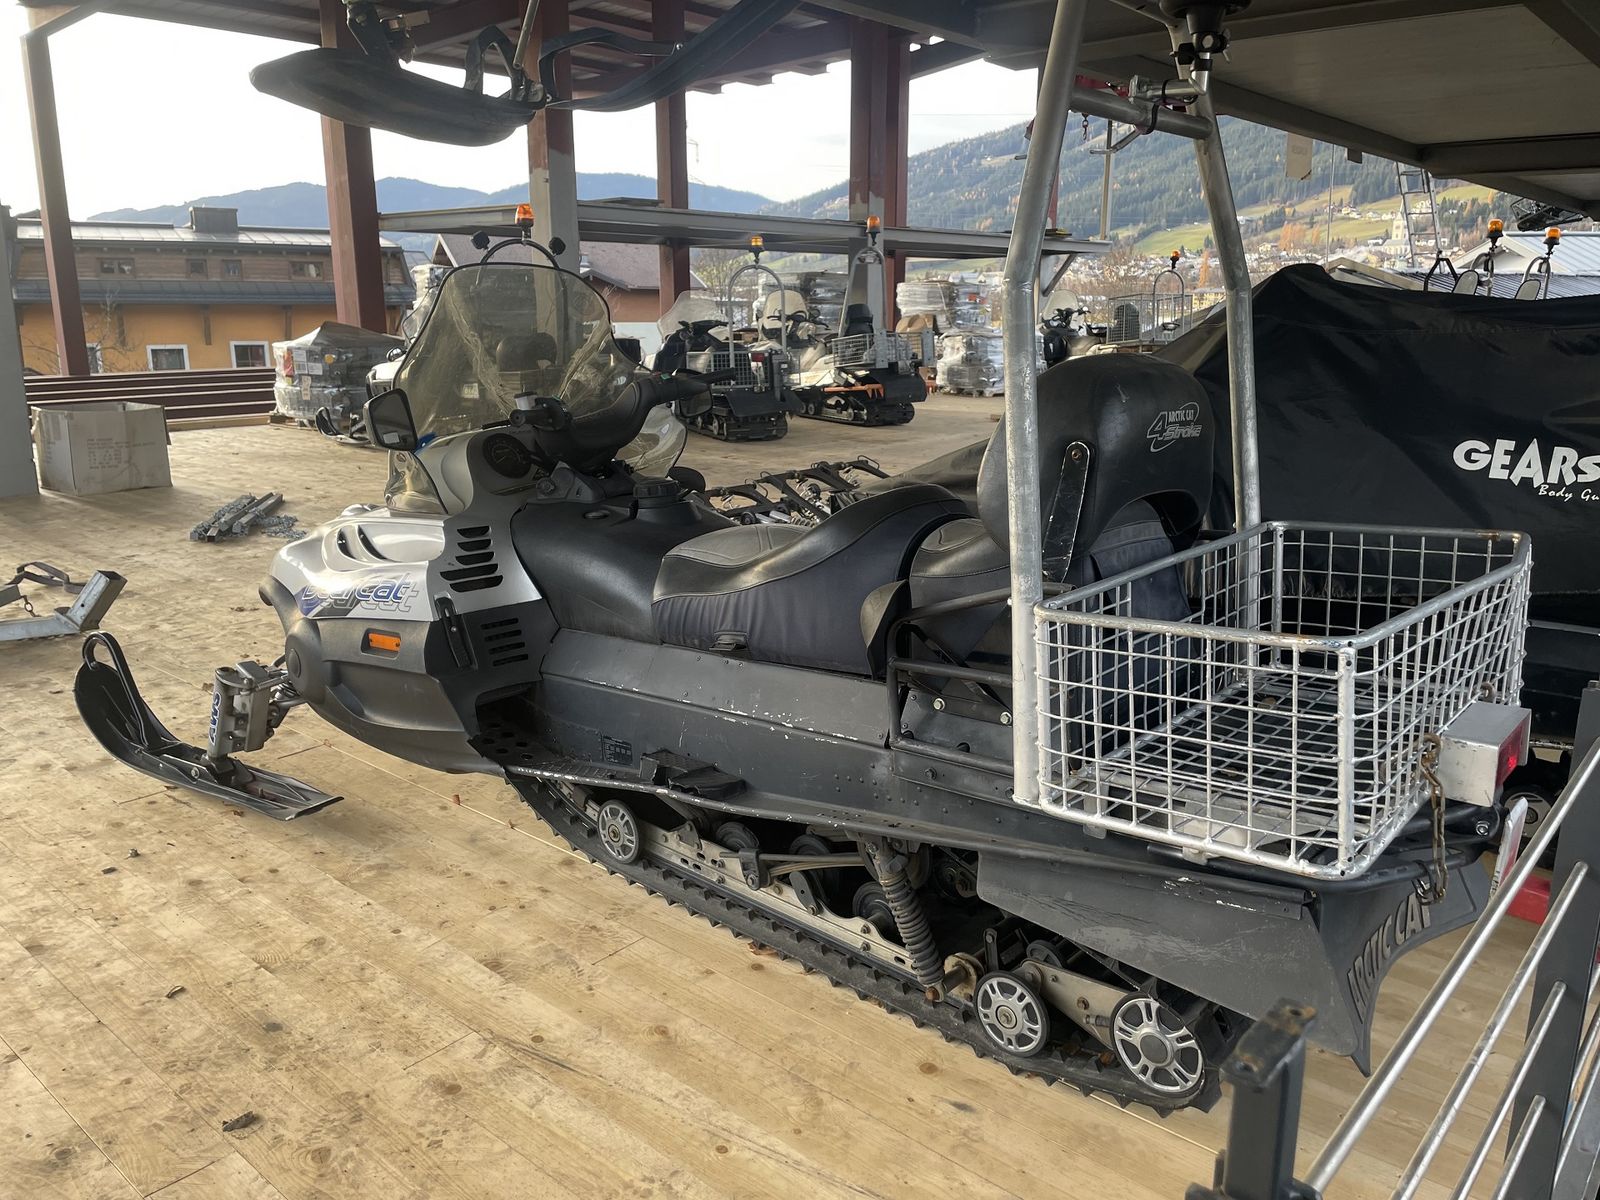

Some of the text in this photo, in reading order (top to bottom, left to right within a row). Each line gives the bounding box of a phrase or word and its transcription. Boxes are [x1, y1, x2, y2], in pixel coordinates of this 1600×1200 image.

[1146, 410, 1168, 440] 4
[1452, 437, 1600, 488] GEARS
[1538, 484, 1573, 502] Body
[208, 691, 221, 746] AWS
[1346, 913, 1392, 1024] ARCTIC
